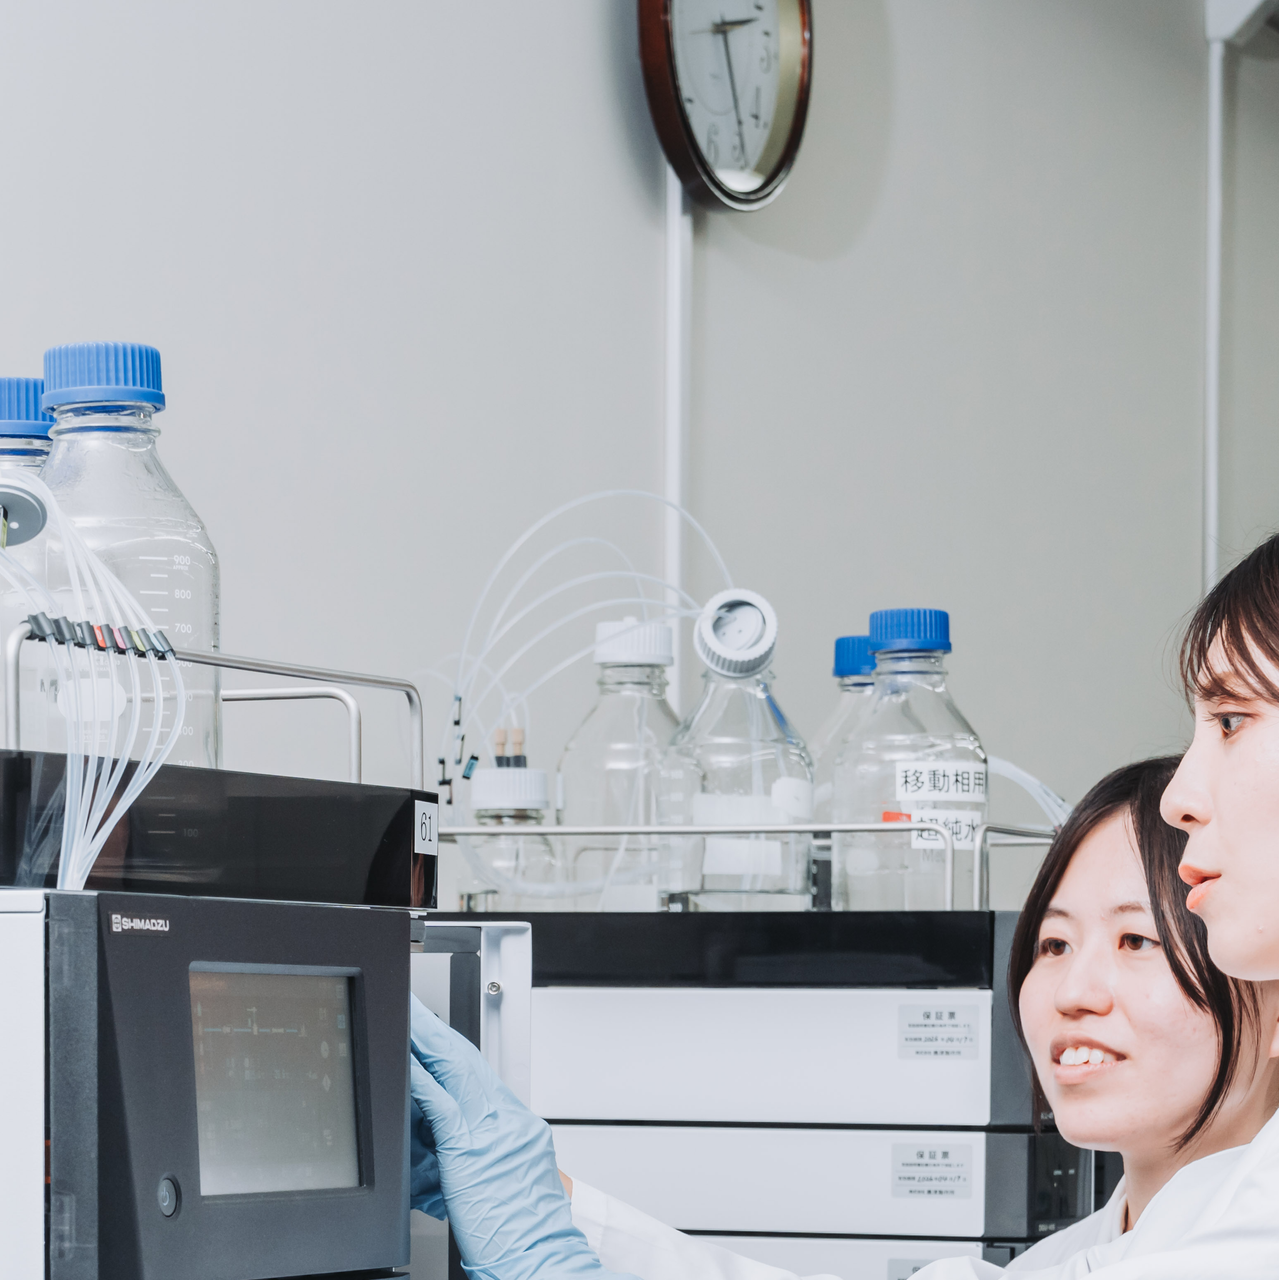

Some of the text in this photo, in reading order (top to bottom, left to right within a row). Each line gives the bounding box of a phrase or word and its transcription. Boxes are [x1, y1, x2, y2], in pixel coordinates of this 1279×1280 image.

[173, 555, 191, 565] 900
[174, 590, 192, 599] 800
[175, 624, 192, 634] 700
[901, 769, 985, 793] 移動相用
[420, 812, 433, 842] 61
[121, 916, 170, 932] SHIMADZU
